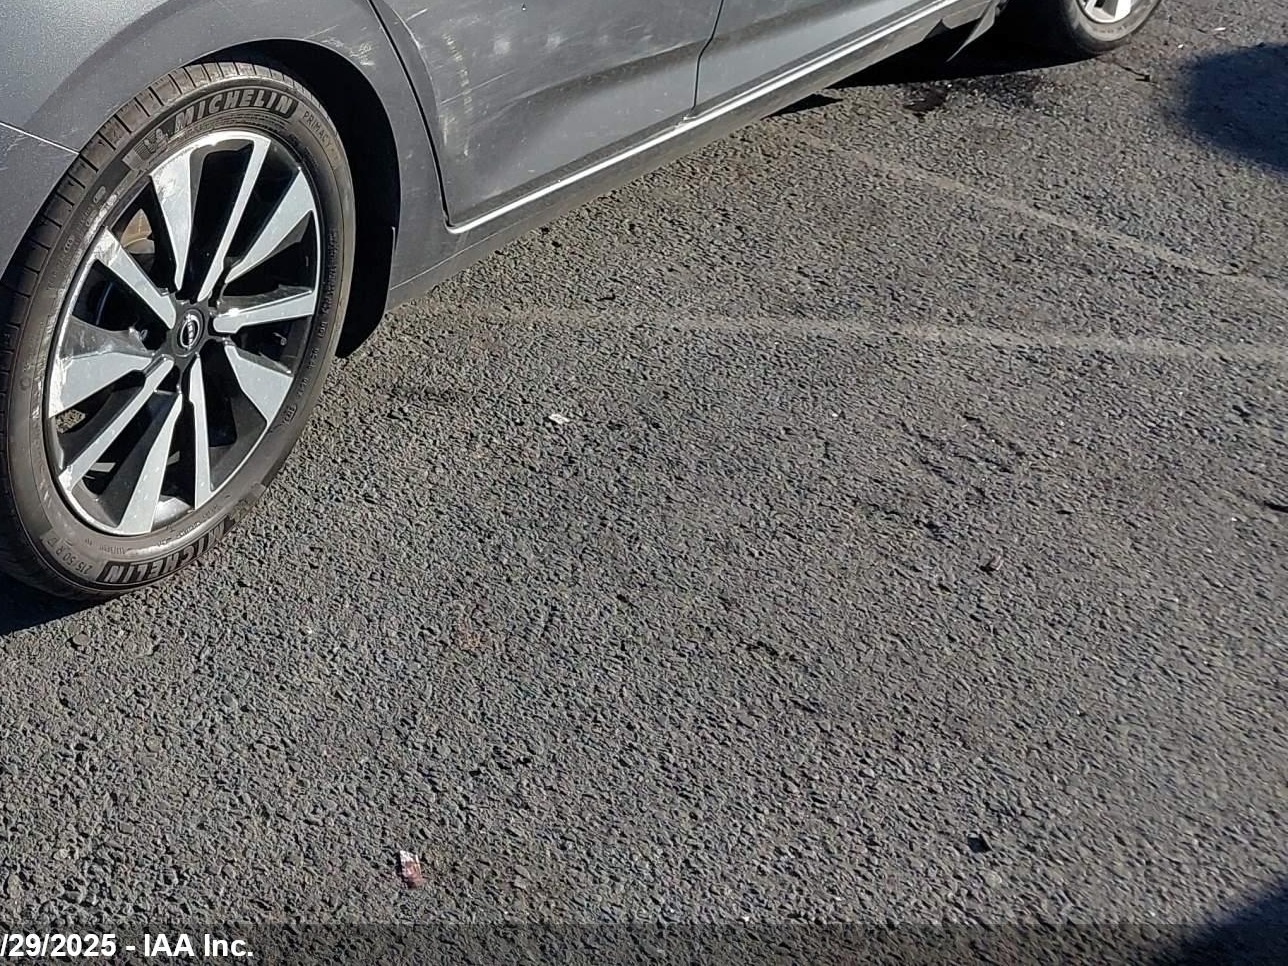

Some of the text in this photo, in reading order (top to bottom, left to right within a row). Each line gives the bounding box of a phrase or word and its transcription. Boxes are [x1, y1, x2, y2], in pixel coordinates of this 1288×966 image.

[174, 88, 295, 133] MICHELIN
[302, 110, 331, 148] PRIMACY
[103, 518, 226, 584] MICHELIN
